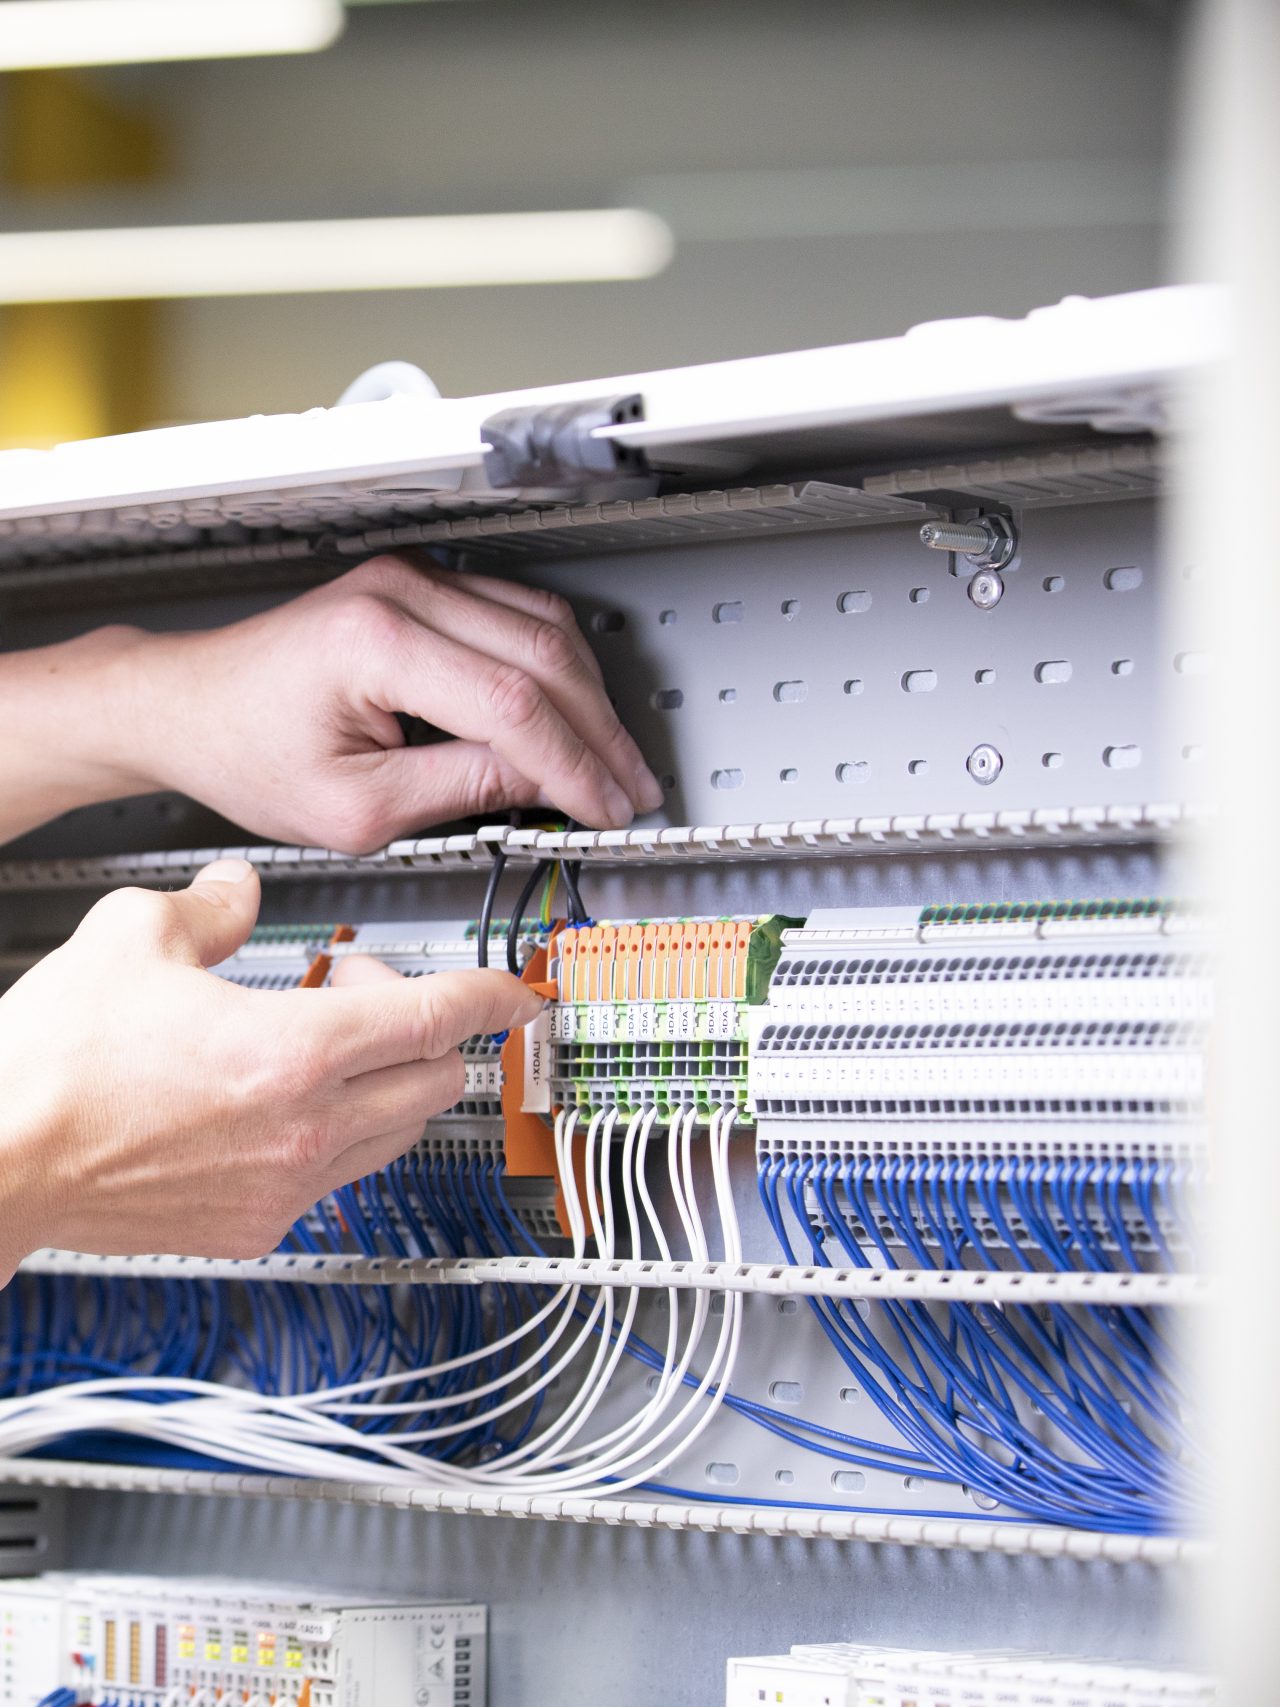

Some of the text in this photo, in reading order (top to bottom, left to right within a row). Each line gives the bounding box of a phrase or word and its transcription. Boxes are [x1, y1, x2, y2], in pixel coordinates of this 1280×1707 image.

[532, 1042, 540, 1086] -1XDALI
[476, 1072, 483, 1084] 30
[488, 1071, 495, 1084] 32
